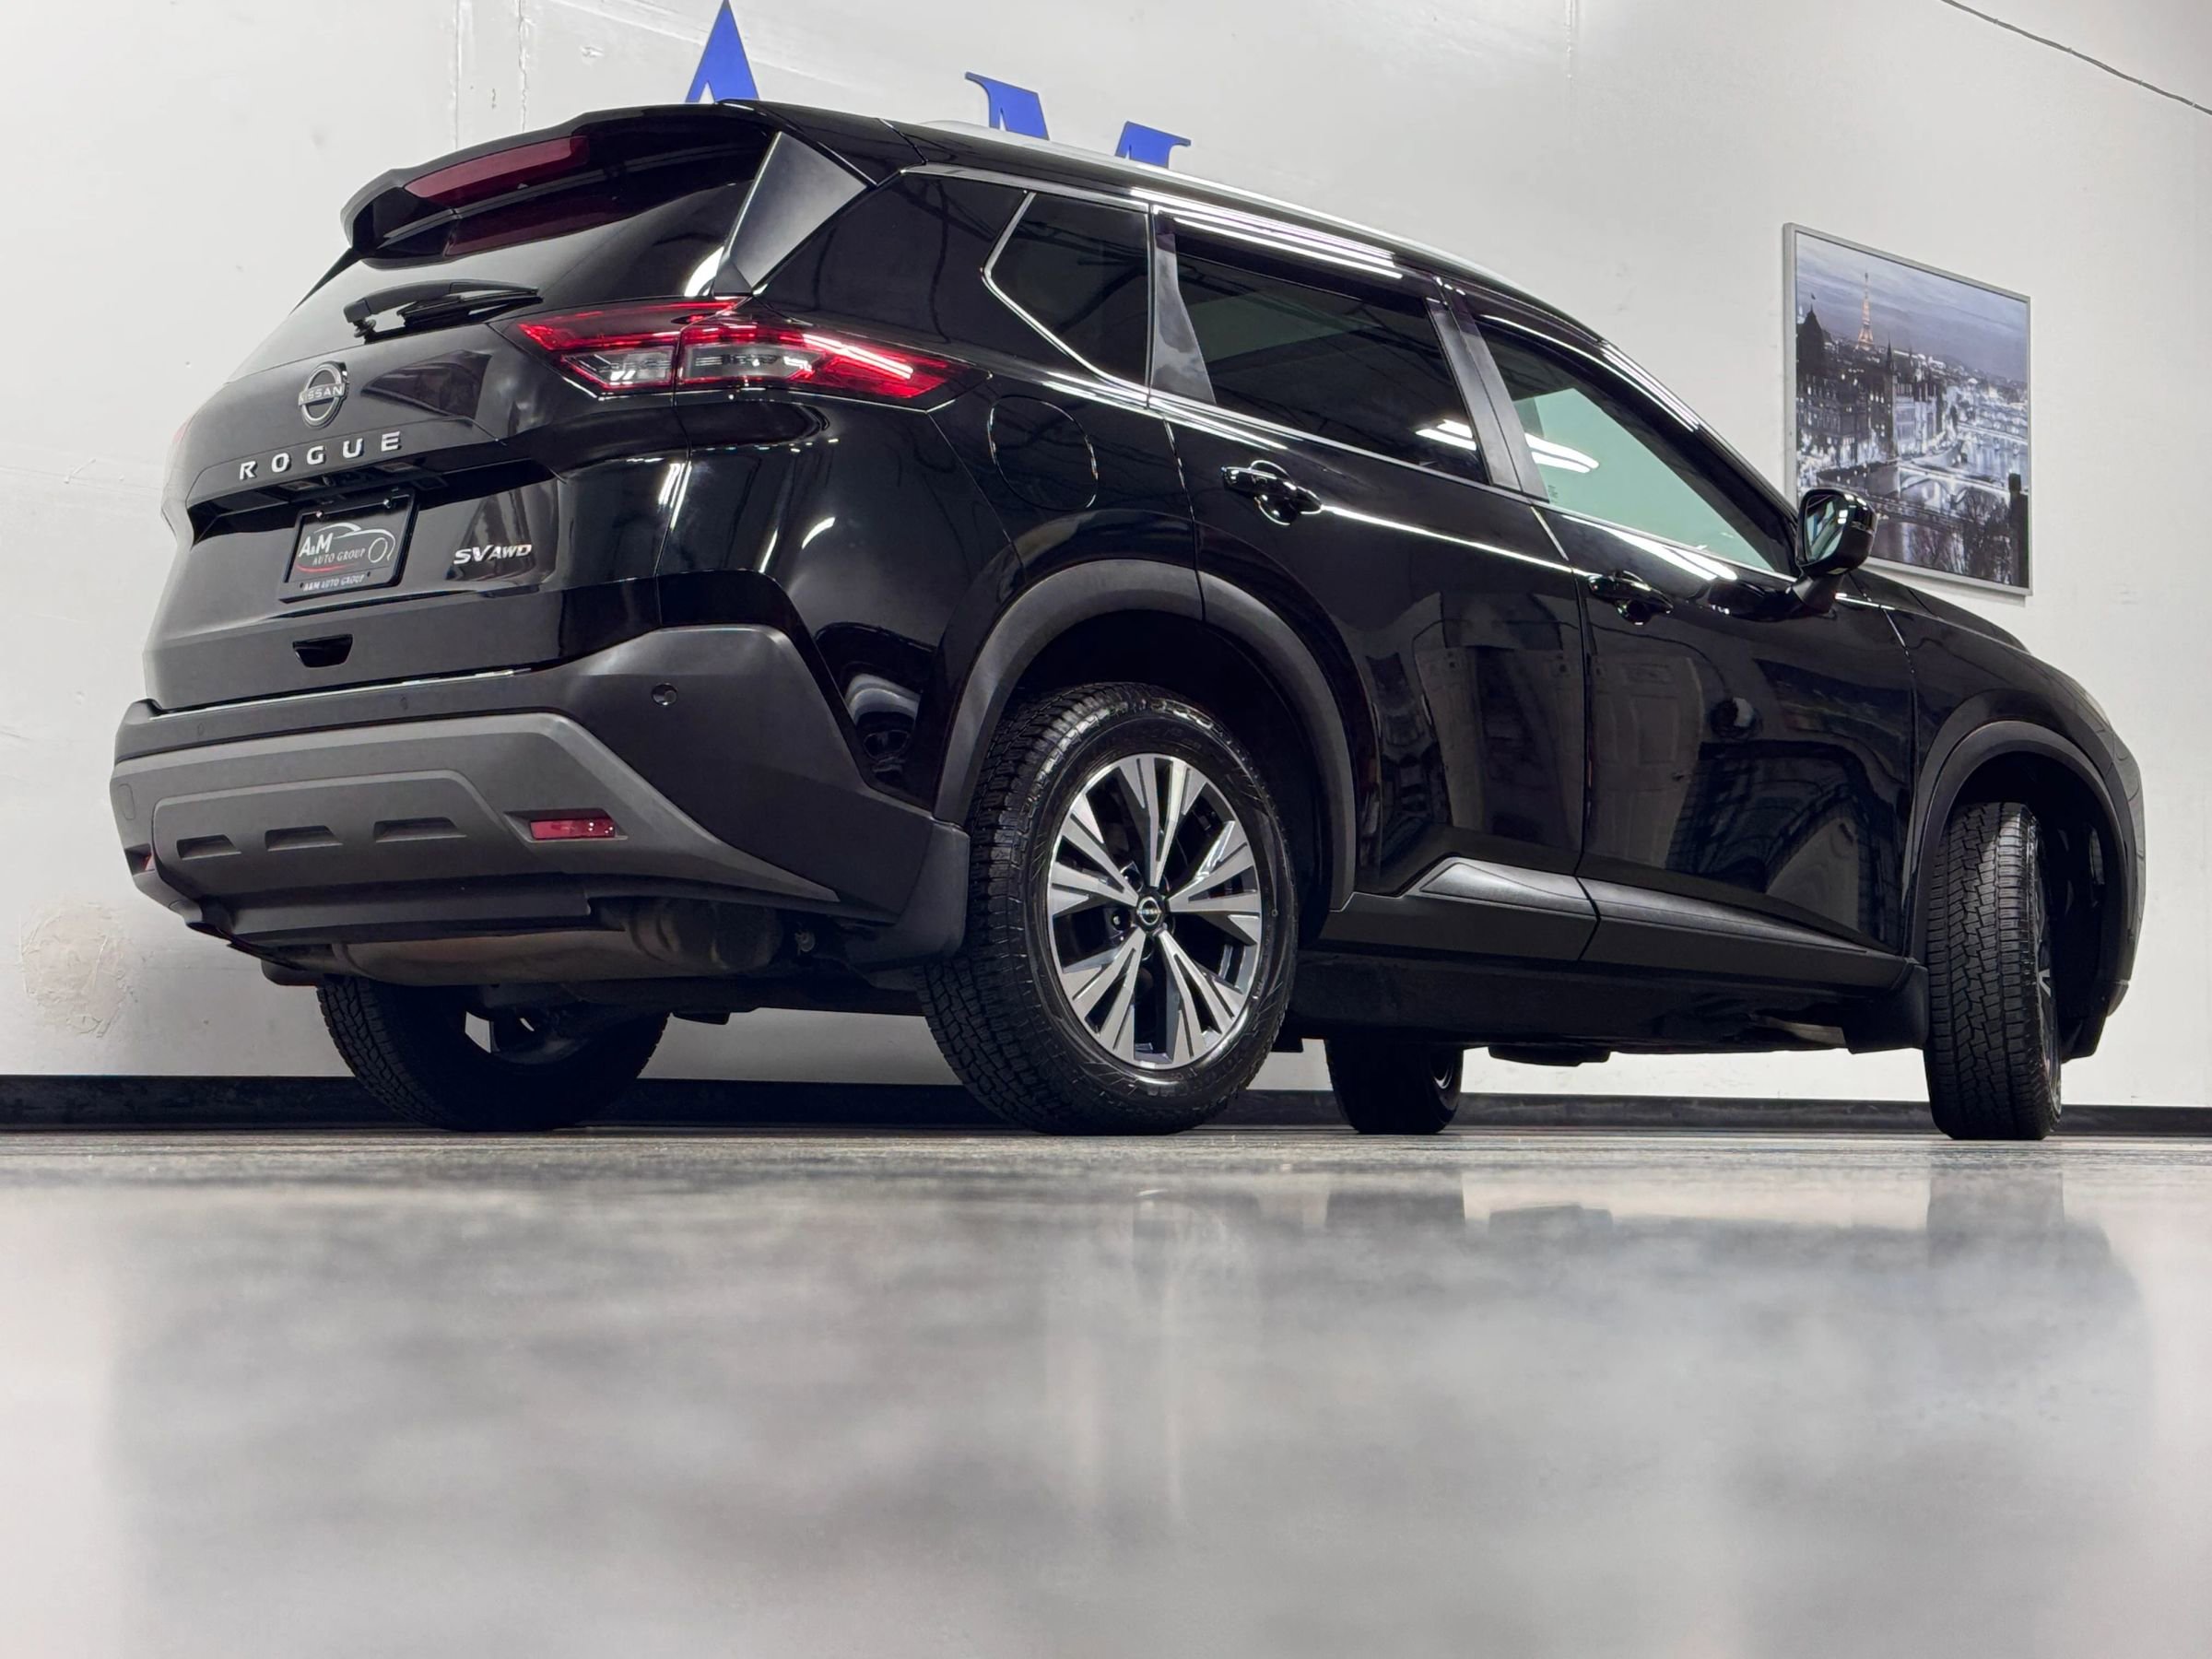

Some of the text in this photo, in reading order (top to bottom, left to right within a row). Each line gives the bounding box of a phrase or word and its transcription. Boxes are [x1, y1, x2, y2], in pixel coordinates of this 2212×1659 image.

[299, 385, 343, 406] NISSAN
[239, 430, 400, 480] ROGUE
[298, 533, 334, 558] A&M
[312, 547, 366, 566] AUTO GROUP
[322, 578, 339, 589] AUTO
[340, 573, 366, 586] GROUP
